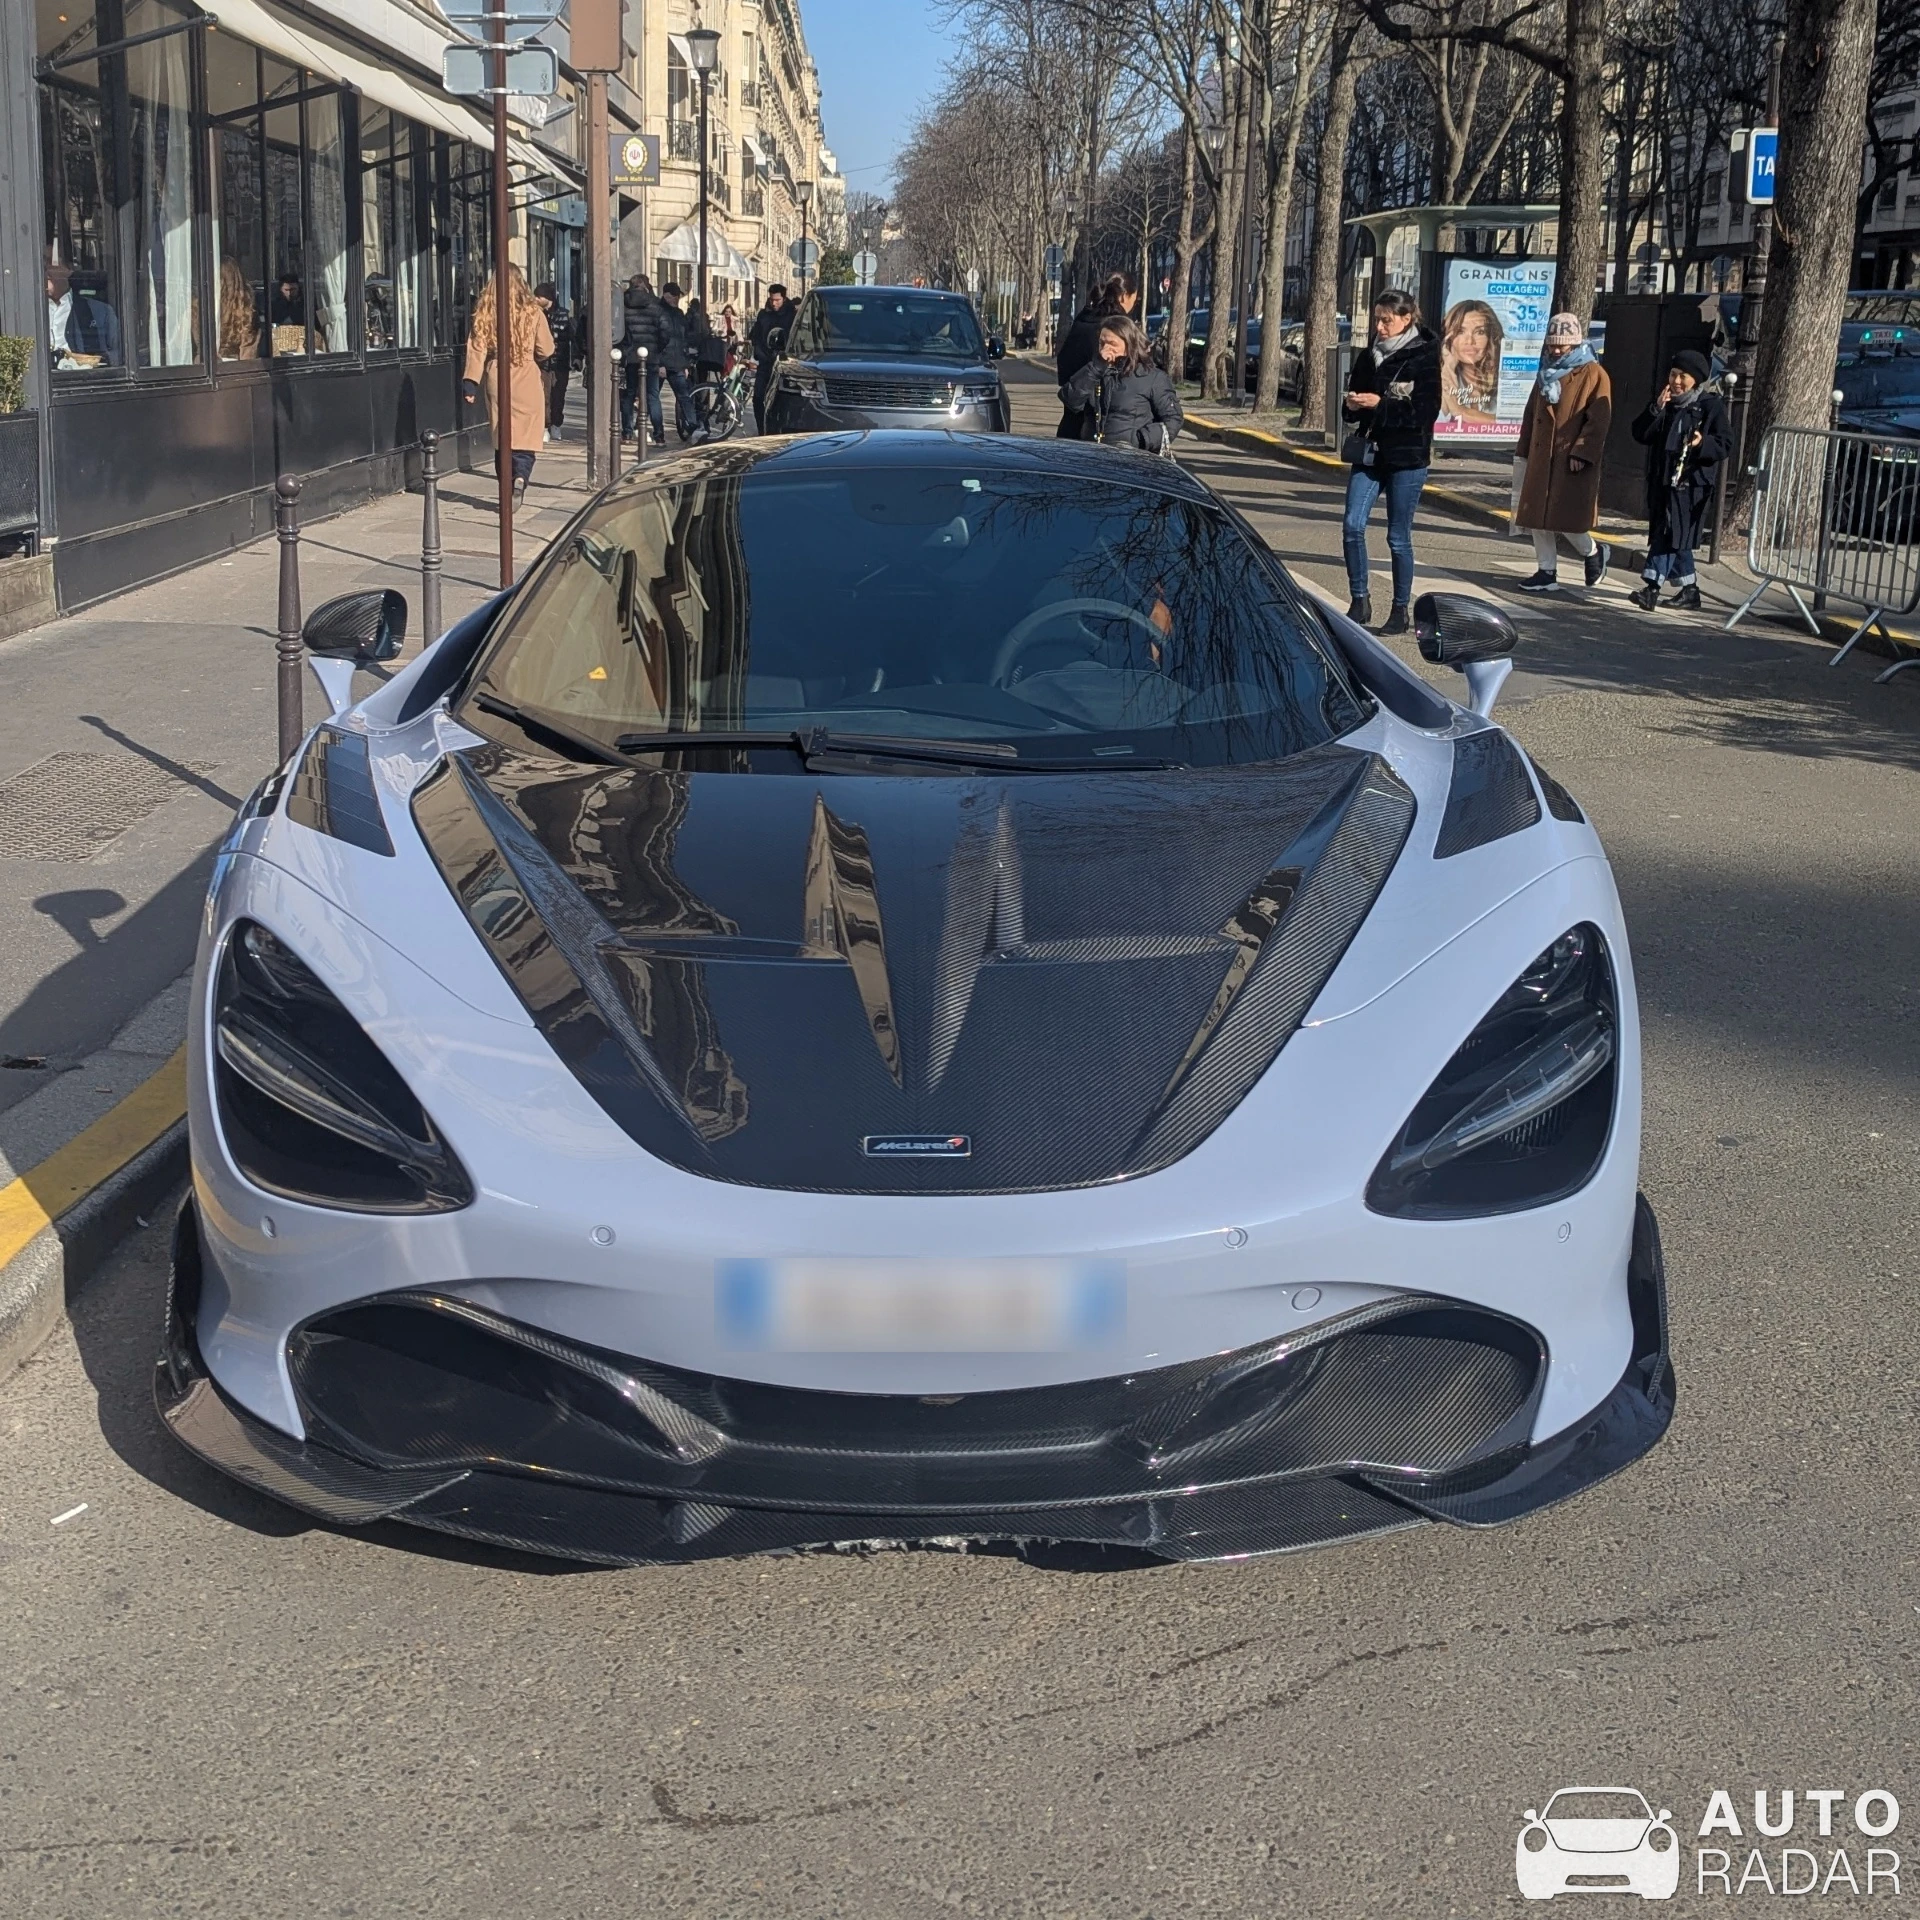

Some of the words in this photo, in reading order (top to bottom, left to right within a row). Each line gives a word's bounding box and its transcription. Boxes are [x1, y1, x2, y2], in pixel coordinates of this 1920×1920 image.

[1756, 156, 1775, 176] TA
[1449, 383, 1474, 398] Ingrid
[873, 1142, 955, 1150] McLaren
